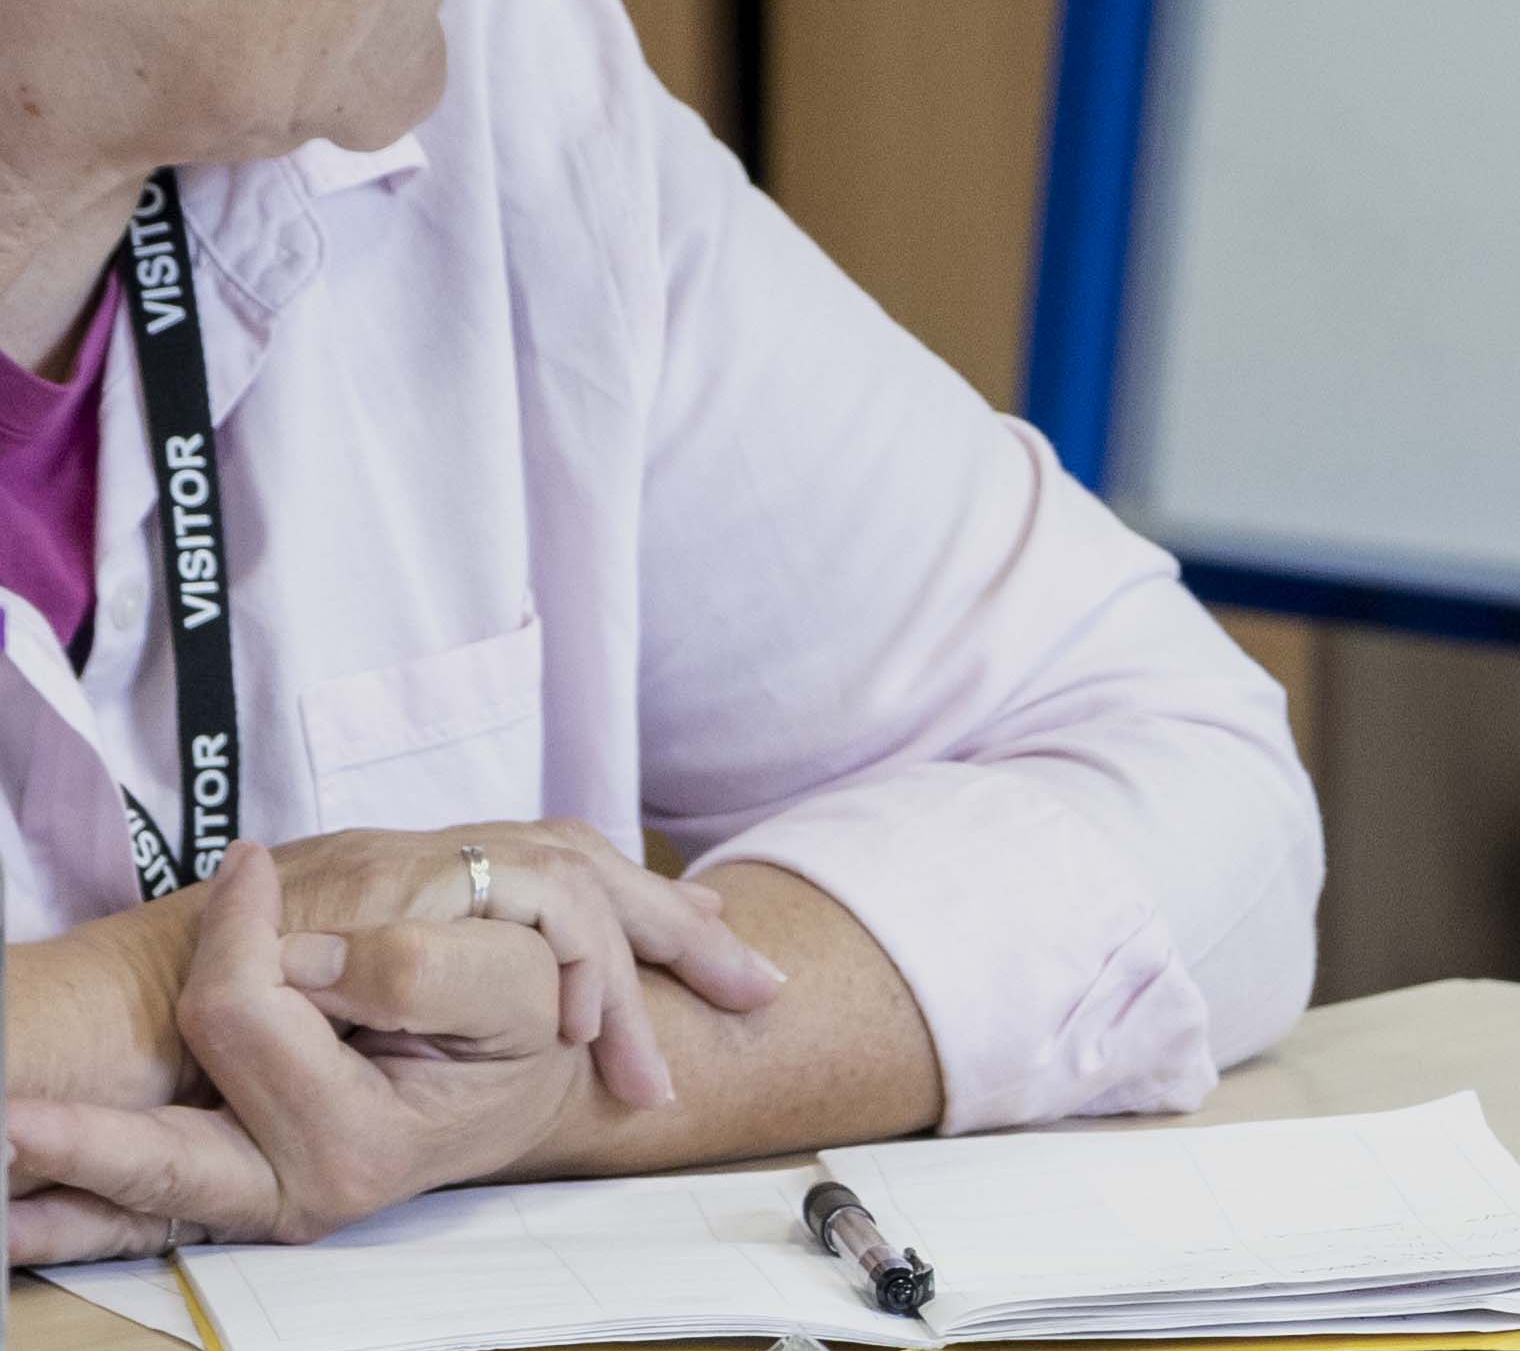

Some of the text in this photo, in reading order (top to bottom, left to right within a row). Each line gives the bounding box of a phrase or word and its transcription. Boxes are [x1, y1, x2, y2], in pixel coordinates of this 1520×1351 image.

[130, 180, 187, 336] VISITO
[165, 432, 222, 630] VISITOR
[192, 731, 230, 881] SITOR
